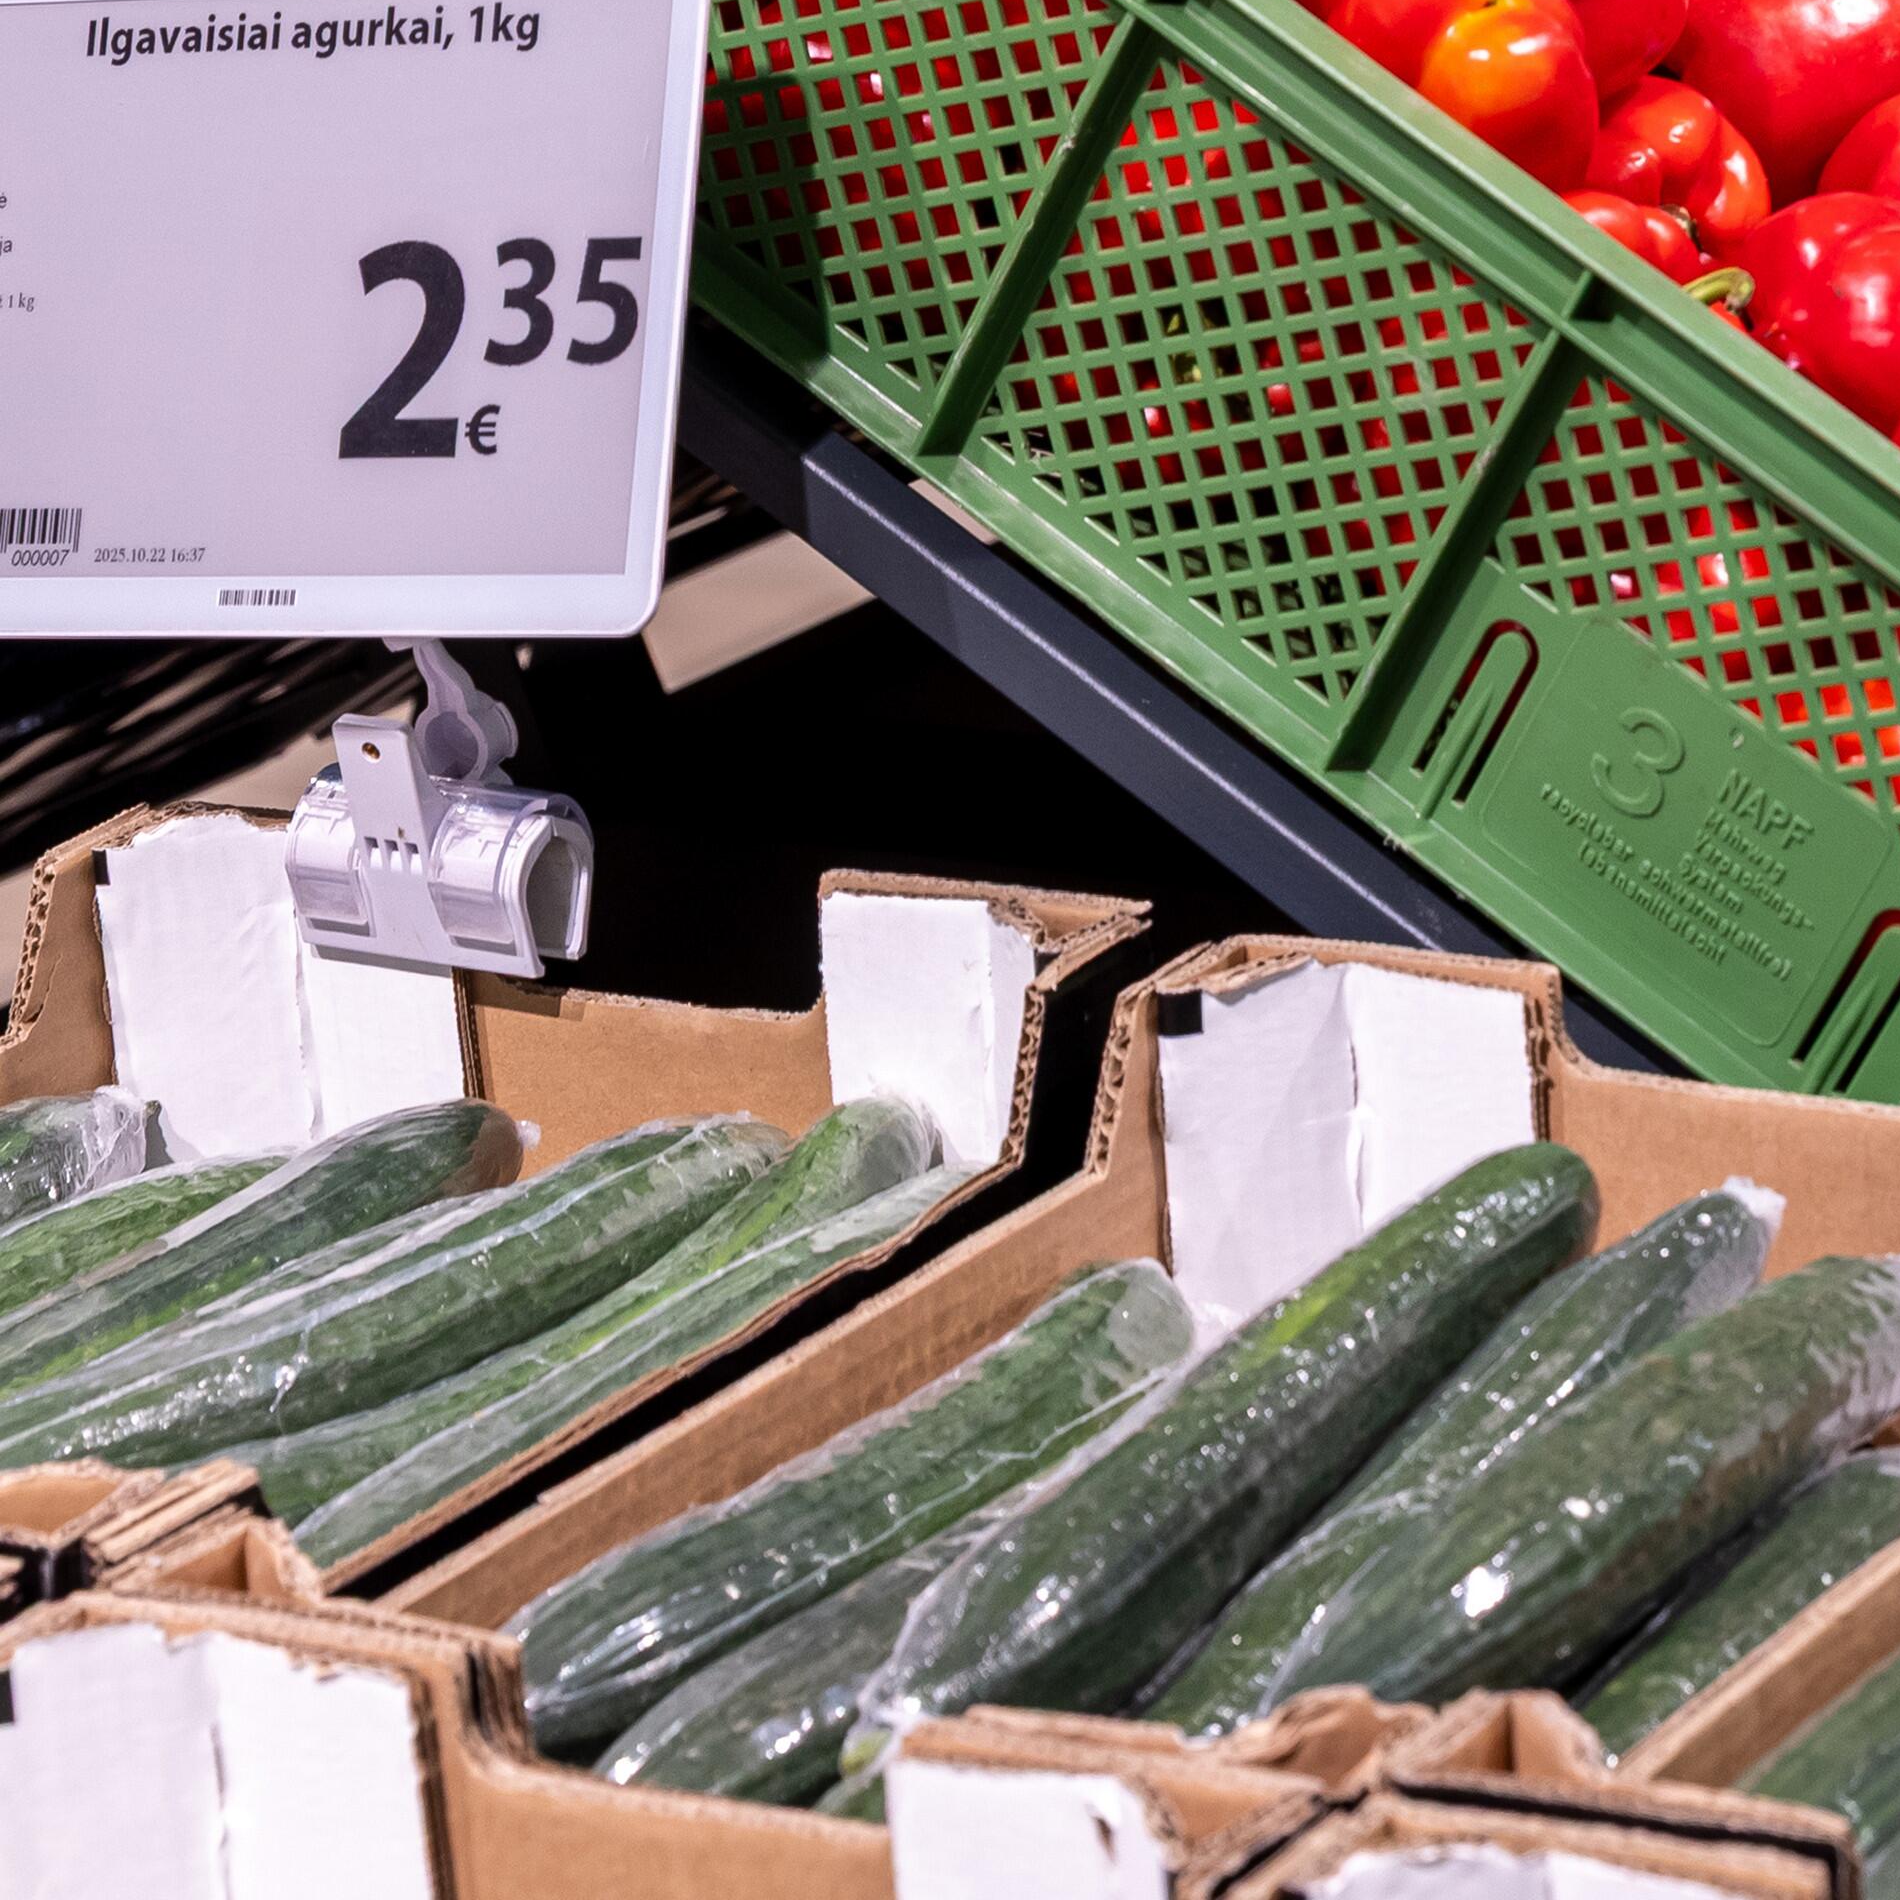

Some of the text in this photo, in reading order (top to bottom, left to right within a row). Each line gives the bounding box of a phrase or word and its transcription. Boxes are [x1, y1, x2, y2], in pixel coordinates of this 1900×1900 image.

[86, 3, 541, 66] Ilgavaisiai agurkai, 1kg
[18, 291, 35, 312] kg
[464, 404, 500, 455] €
[11, 549, 70, 566] 000007
[94, 547, 206, 562] 2025.10.22 16:37
[1590, 706, 1686, 820] 3
[1719, 767, 1815, 850] NAPF
[1706, 807, 1787, 885] Mehrweg
[1679, 852, 1745, 915] System
